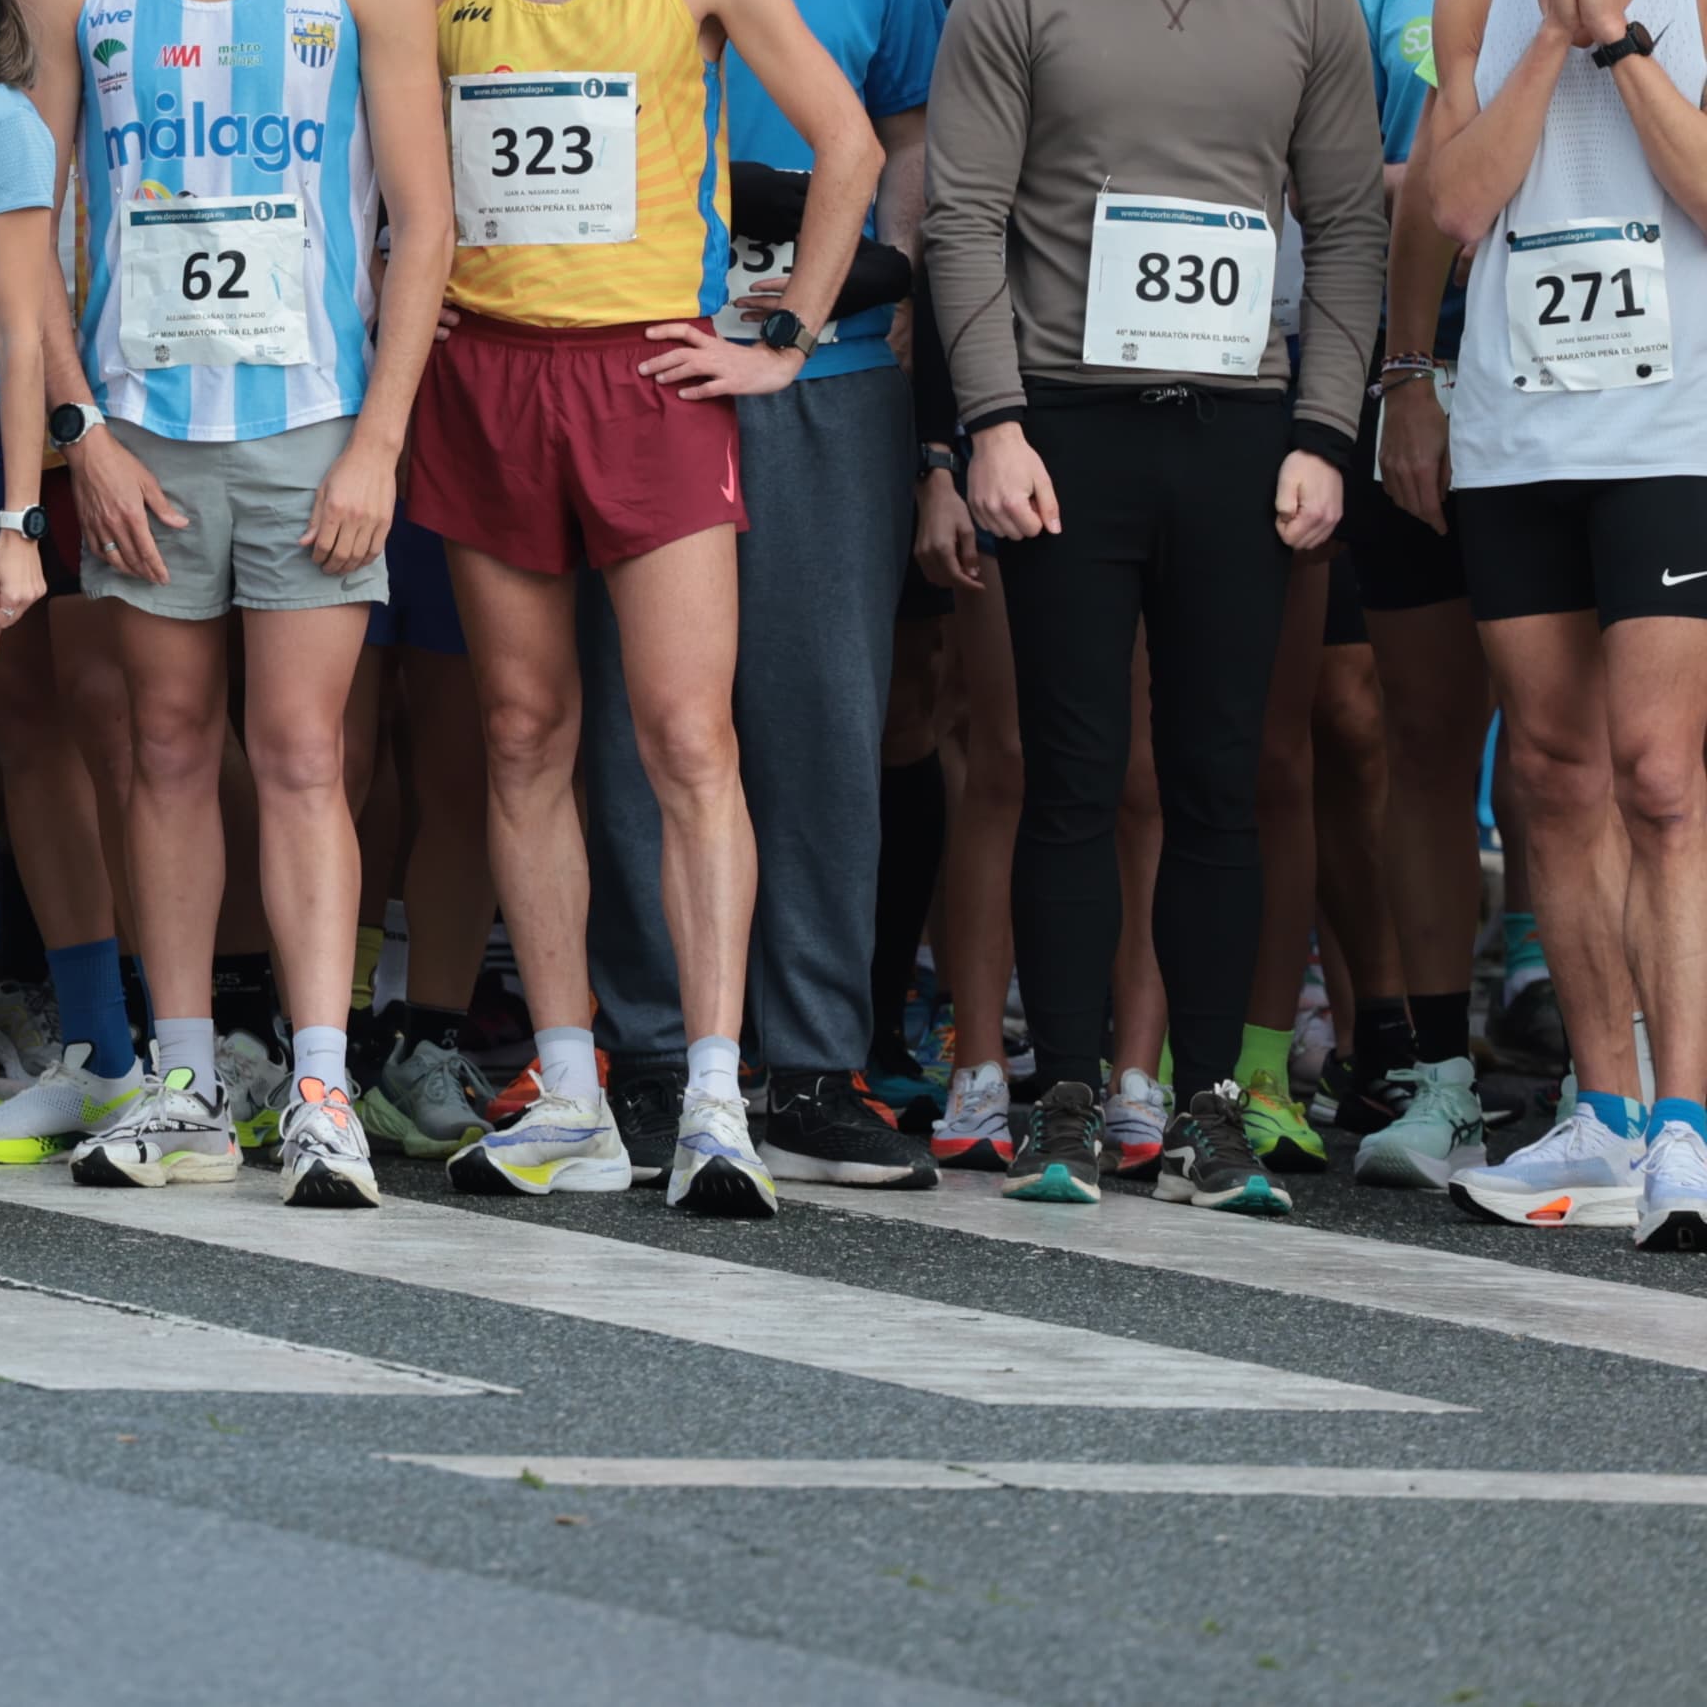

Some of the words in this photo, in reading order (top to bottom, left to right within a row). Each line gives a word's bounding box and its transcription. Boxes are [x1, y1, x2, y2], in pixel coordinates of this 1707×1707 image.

[88, 8, 132, 28] vive
[218, 43, 261, 54] metro
[474, 85, 555, 96] www.deporte.malaga.eu
[491, 125, 594, 178] 323
[489, 206, 504, 214] MINI
[505, 203, 542, 214] MARATÓN
[543, 202, 564, 212] PEÑA
[566, 204, 577, 212] EL
[578, 202, 612, 212] BASTÓN
[1121, 209, 1205, 223] www.deporte.malaga.eu
[182, 250, 250, 301] 62
[1136, 252, 1240, 307] 830
[1536, 267, 1646, 326] 271
[161, 330, 177, 338] MINI
[177, 328, 217, 338] MARATÓN
[242, 328, 252, 336] EL
[1129, 330, 1148, 338] MINI
[1149, 330, 1189, 340] MARATÓN
[1191, 331, 1212, 341] PEÑA
[1213, 334, 1221, 342] EL
[1223, 334, 1251, 343] BASTÓN
[1577, 333, 1610, 343] MARTÍNEZ
[1556, 350, 1597, 361] MARATÓN
[1598, 348, 1619, 357] PEÑA
[1622, 347, 1632, 355] EL
